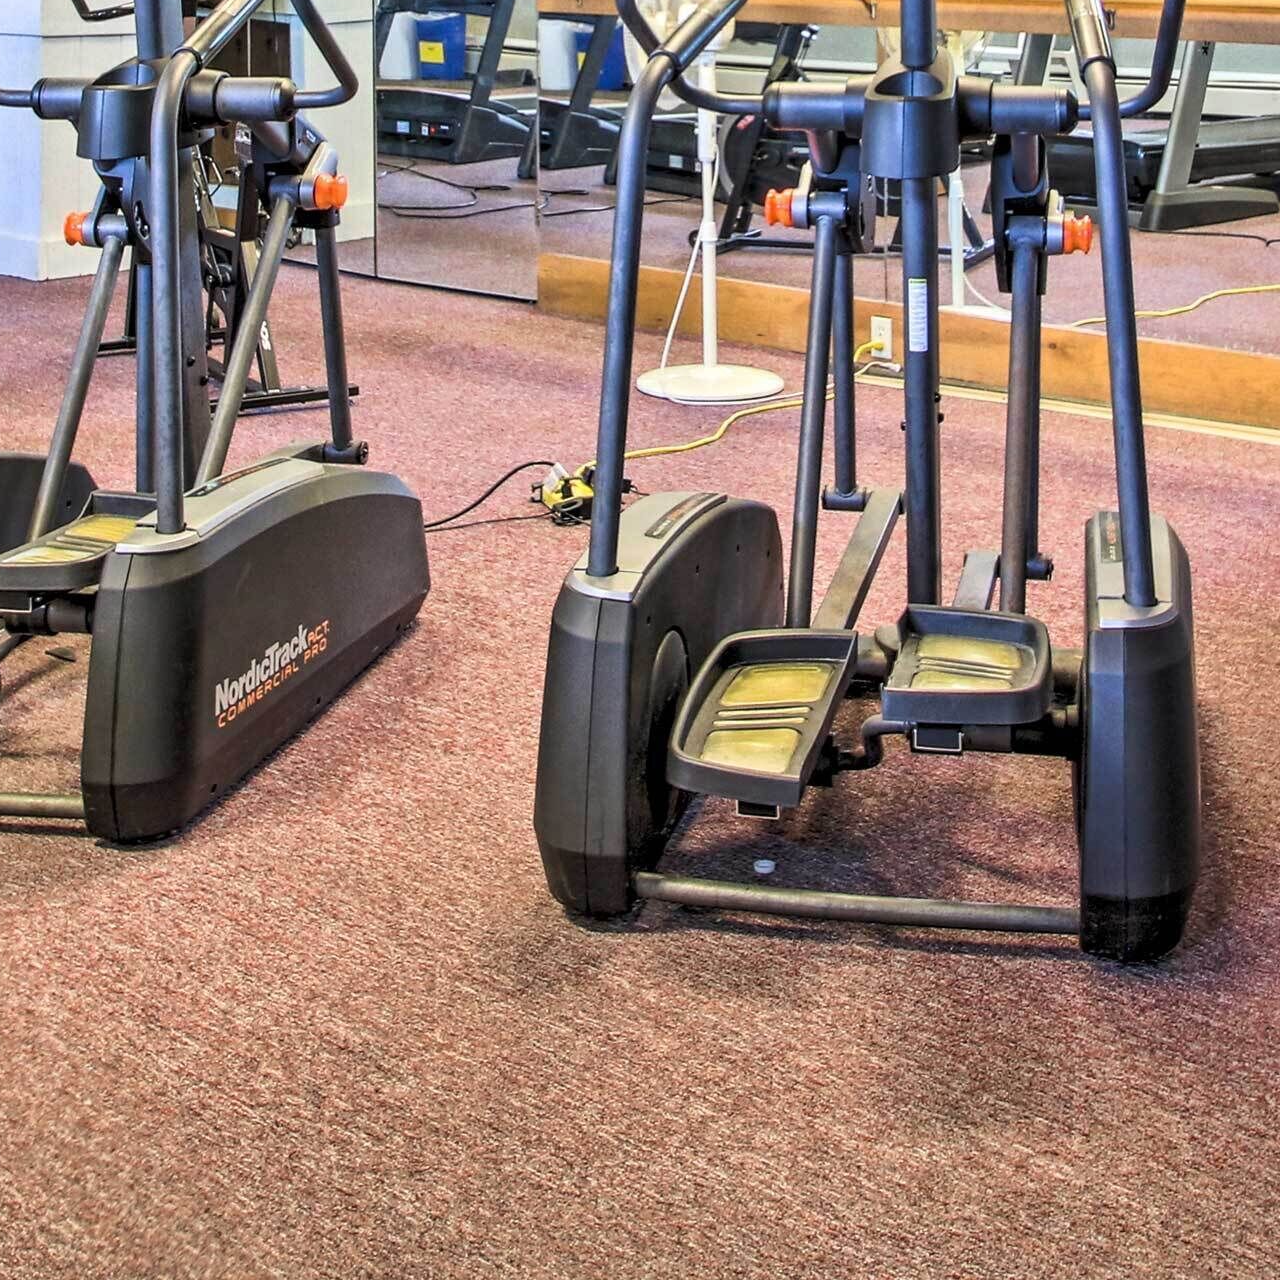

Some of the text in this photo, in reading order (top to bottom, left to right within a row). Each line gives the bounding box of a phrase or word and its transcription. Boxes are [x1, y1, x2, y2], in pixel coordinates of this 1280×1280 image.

[215, 624, 308, 716] NordicTrack
[218, 637, 328, 728] COMMERCIAL PRO
